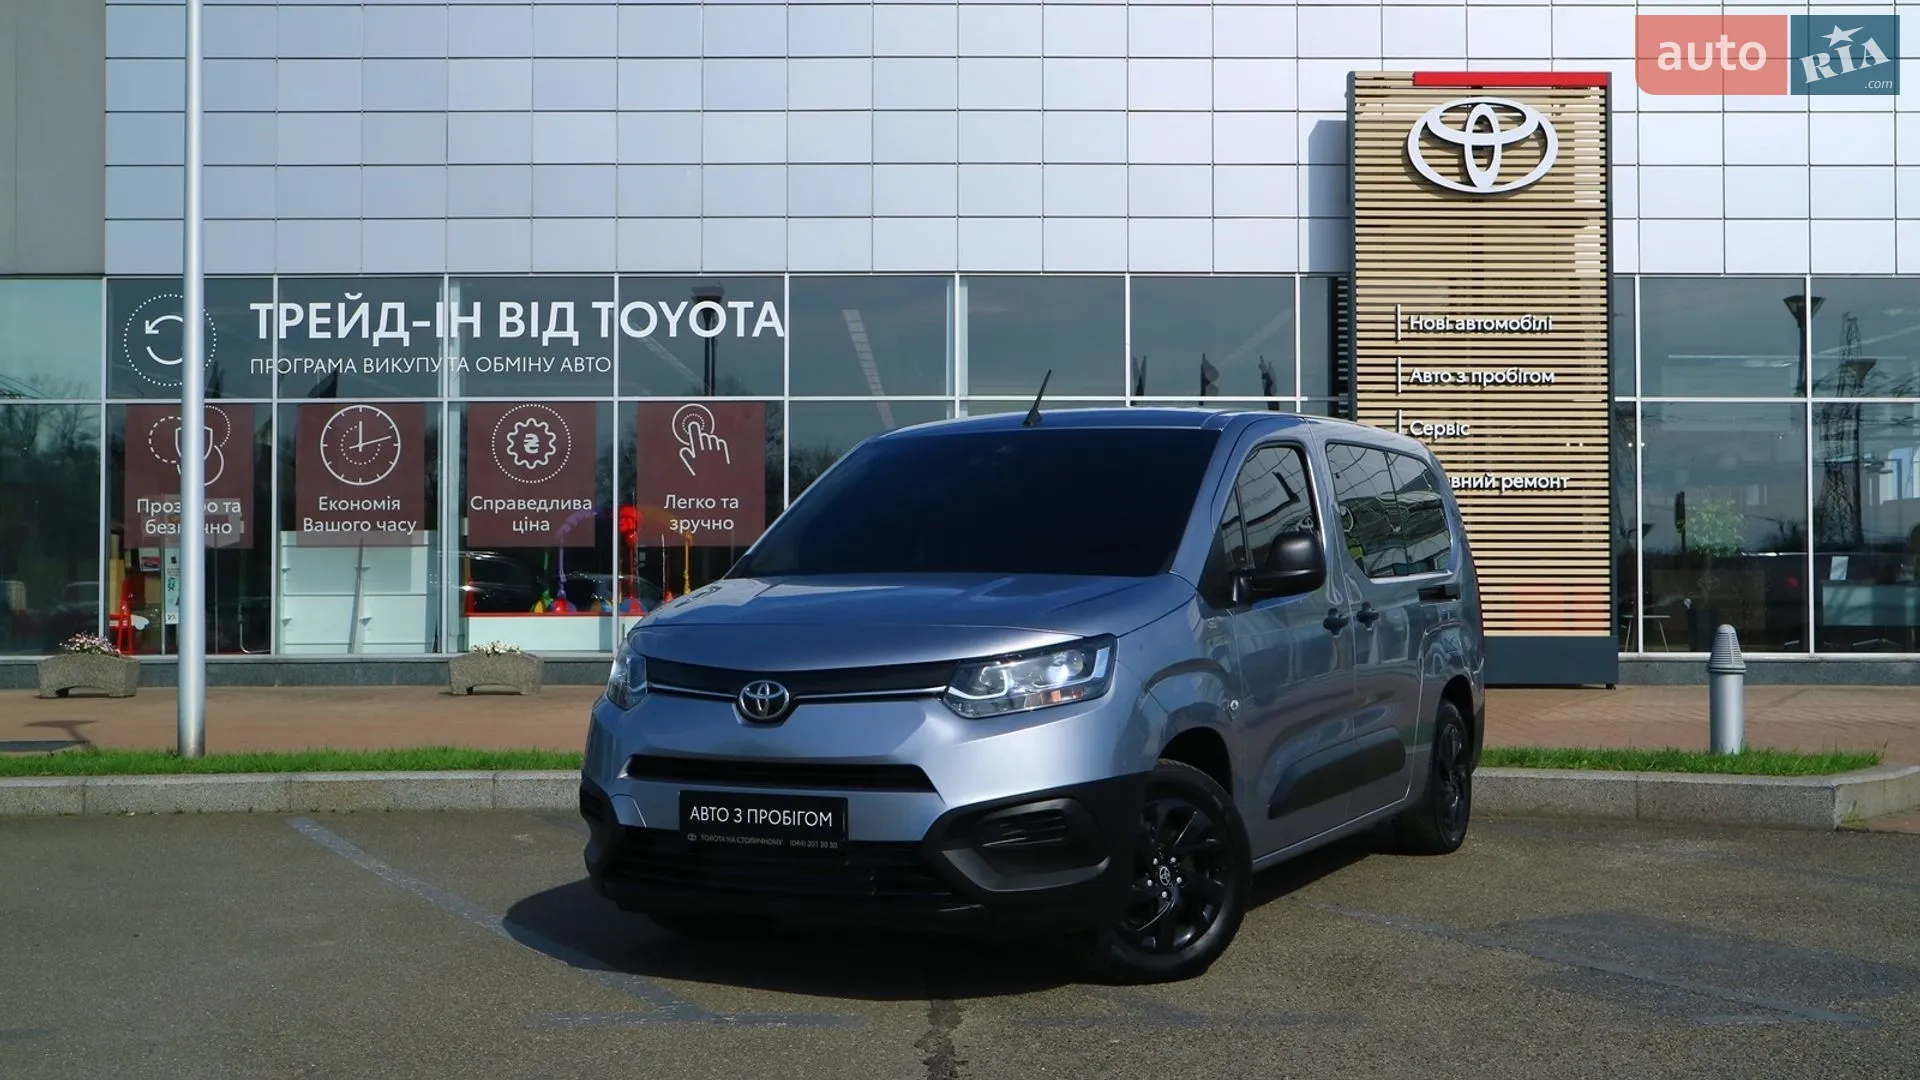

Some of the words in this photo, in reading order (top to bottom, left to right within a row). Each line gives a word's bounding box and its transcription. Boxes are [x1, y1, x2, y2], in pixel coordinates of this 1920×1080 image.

[250, 292, 481, 346] ТРЕЙД-ІН
[500, 301, 579, 346] ВІД
[592, 301, 785, 338] TOYOTA
[1409, 315, 1450, 331] Нові
[1455, 315, 1553, 331] автомобілі
[251, 358, 357, 374] ПРОГРАМА
[364, 357, 442, 373] ВИКУПУ
[447, 357, 470, 372] ТА
[475, 357, 556, 373] ОБМІНУ
[560, 357, 611, 373] АВТО
[1409, 368, 1452, 384] Авто
[1457, 372, 1465, 384] з
[1471, 367, 1555, 388] пробігом
[1409, 420, 1470, 439] Сервіс
[1449, 473, 1496, 489] вний
[1501, 476, 1569, 493] ремонт
[137, 499, 218, 516] Прозо
[223, 502, 241, 513] та
[318, 497, 400, 511] Економія
[470, 496, 592, 511] Справедлива
[664, 495, 715, 511] Легко
[721, 498, 739, 509] та
[145, 519, 232, 534] безчно
[303, 518, 371, 532] Вашого
[376, 521, 417, 535] часу
[512, 519, 550, 534] ціна
[669, 518, 734, 533] зручно
[690, 806, 730, 823] АВТО
[747, 809, 833, 827] ПРОБІГОМ
